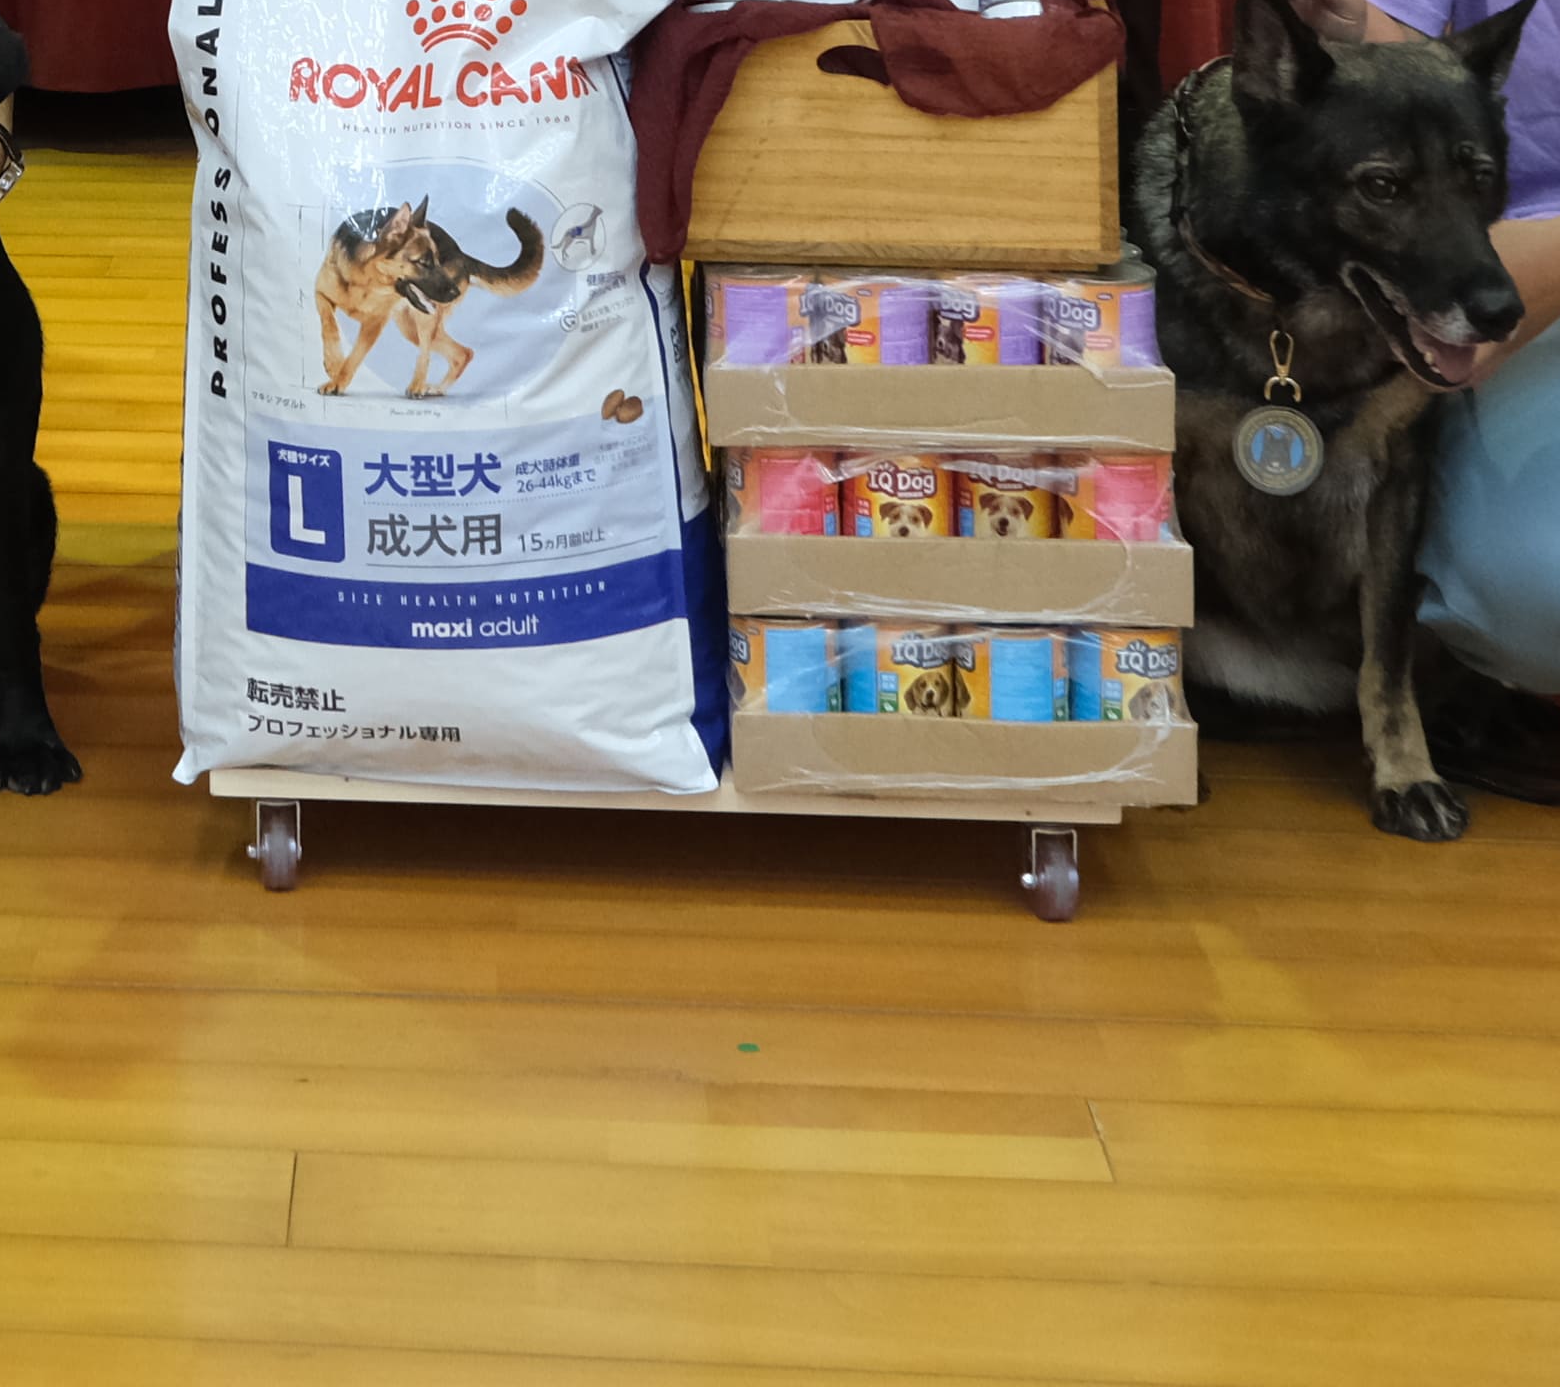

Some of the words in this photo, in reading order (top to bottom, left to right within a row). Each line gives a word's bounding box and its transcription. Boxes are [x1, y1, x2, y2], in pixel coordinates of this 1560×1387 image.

[288, 56, 442, 114] ROYAL
[403, 121, 472, 133] NUTRITION
[480, 118, 526, 131] SINCE
[1059, 302, 1098, 327] Dog
[362, 452, 502, 498] 大型犬
[516, 468, 597, 494] 26-44kgまで
[868, 470, 893, 492] IQ
[896, 472, 935, 495] Dog
[287, 474, 327, 546] L
[366, 512, 502, 558] 成犬用
[400, 592, 478, 608] HEALTH
[495, 580, 607, 606] NUTRITION
[411, 616, 473, 639] maxi
[479, 614, 540, 637] adult
[893, 642, 919, 664] IQ
[1116, 650, 1144, 672] IQ
[1147, 650, 1179, 671] Dog
[246, 676, 346, 714] 転売禁止
[246, 714, 461, 744] プロフェッショナル専用
